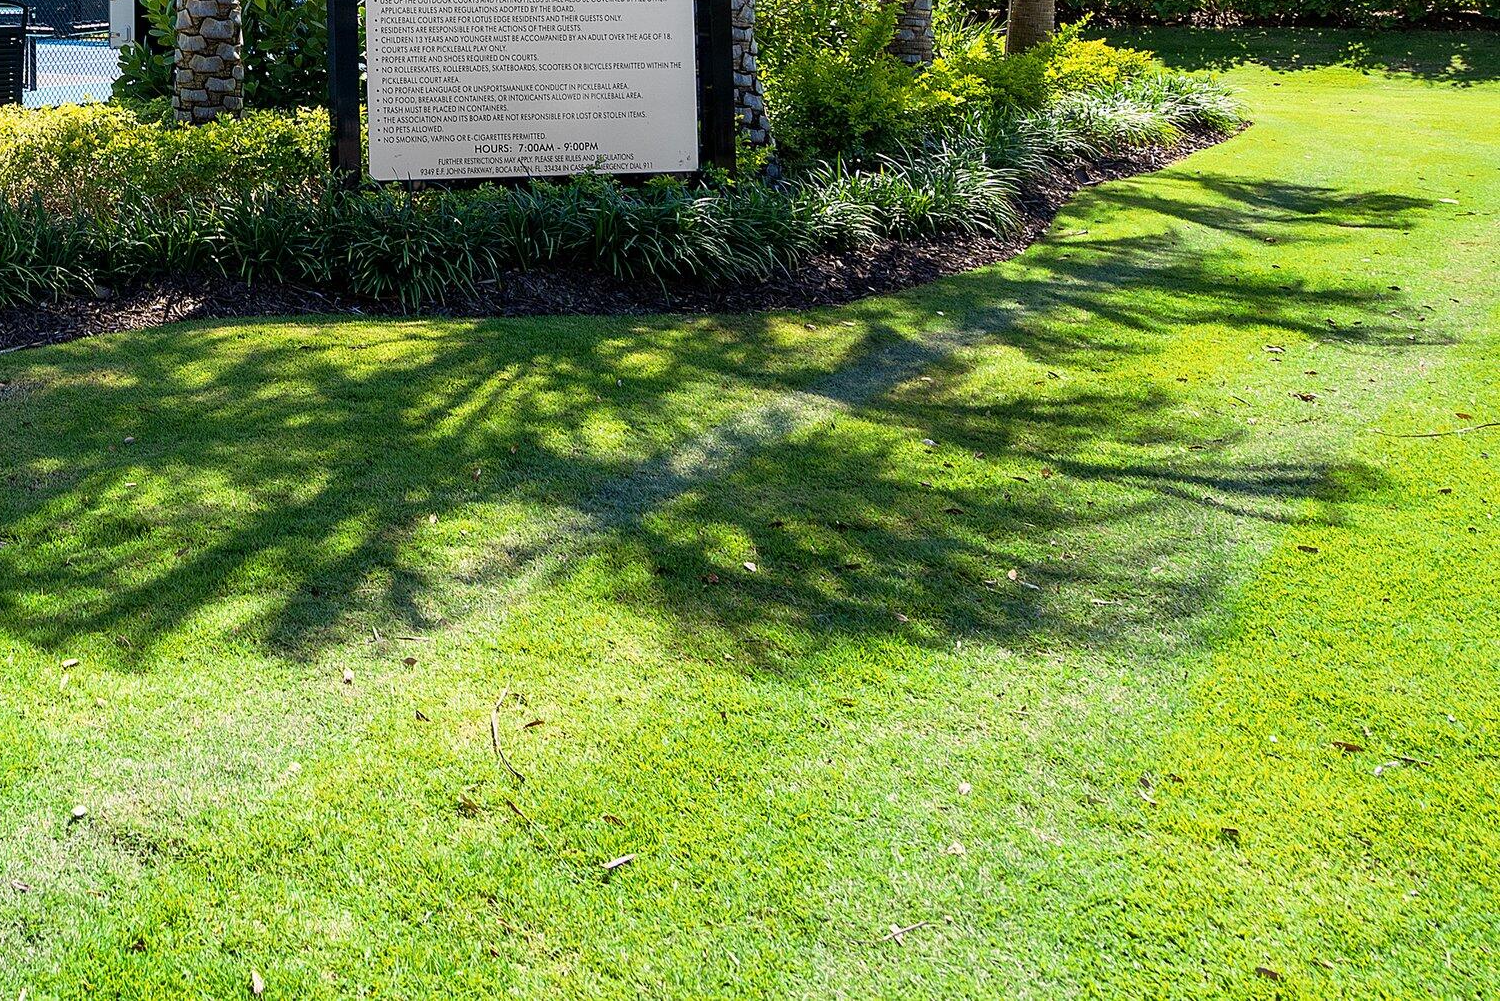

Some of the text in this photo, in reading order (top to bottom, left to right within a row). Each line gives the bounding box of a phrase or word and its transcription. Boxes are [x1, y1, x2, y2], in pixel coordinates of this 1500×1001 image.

[381, 26, 414, 34] RESIDENTS
[428, 25, 469, 33] RESPONSIBLE
[470, 25, 484, 33] FOR
[485, 25, 496, 33] THE
[381, 36, 413, 44] CHILDREN
[460, 35, 492, 43] YOUNGER
[520, 34, 567, 42] ACCOMPANIED
[638, 33, 651, 41] AGE
[436, 45, 471, 53] PICKLEBALL
[472, 45, 487, 53] PLAY
[406, 55, 426, 63] ATTIRE
[428, 55, 442, 63] AND
[443, 55, 465, 63] SHOES
[466, 54, 498, 62] REQUIRED
[498, 54, 510, 62] ON
[381, 66, 393, 74] NO
[538, 63, 572, 71] SCOOTERS
[572, 63, 582, 71] OR
[612, 62, 645, 70] PERMITTED
[418, 76, 441, 84] COURT
[394, 86, 424, 94] PROFANE
[462, 85, 472, 93] OR
[576, 83, 611, 91] PICKLEBALL
[507, 94, 550, 102] INTOXICANTS
[551, 93, 581, 101] ALLOWED
[590, 92, 625, 100] PICKLEBALL
[383, 106, 403, 114] TRASH
[432, 105, 456, 113] PLACED
[383, 116, 395, 124] THE
[396, 115, 442, 124] ASSOCIATION
[442, 115, 457, 123] AND
[468, 114, 491, 122] BOARD
[492, 114, 504, 122] ARE
[520, 113, 561, 121] RESPONSIBLE
[561, 112, 575, 120] FOR
[575, 112, 591, 120] LOST
[602, 111, 626, 119] STOLEN
[383, 126, 394, 134] NO
[395, 126, 410, 134] PETS
[383, 136, 394, 144] NO
[430, 135, 455, 143] VAPING
[456, 134, 466, 142] OR
[466, 133, 511, 142] E-CIGARETTES
[474, 144, 512, 154] HOURS:
[518, 144, 554, 152] 7:00AM
[563, 142, 598, 151] 9:00PM
